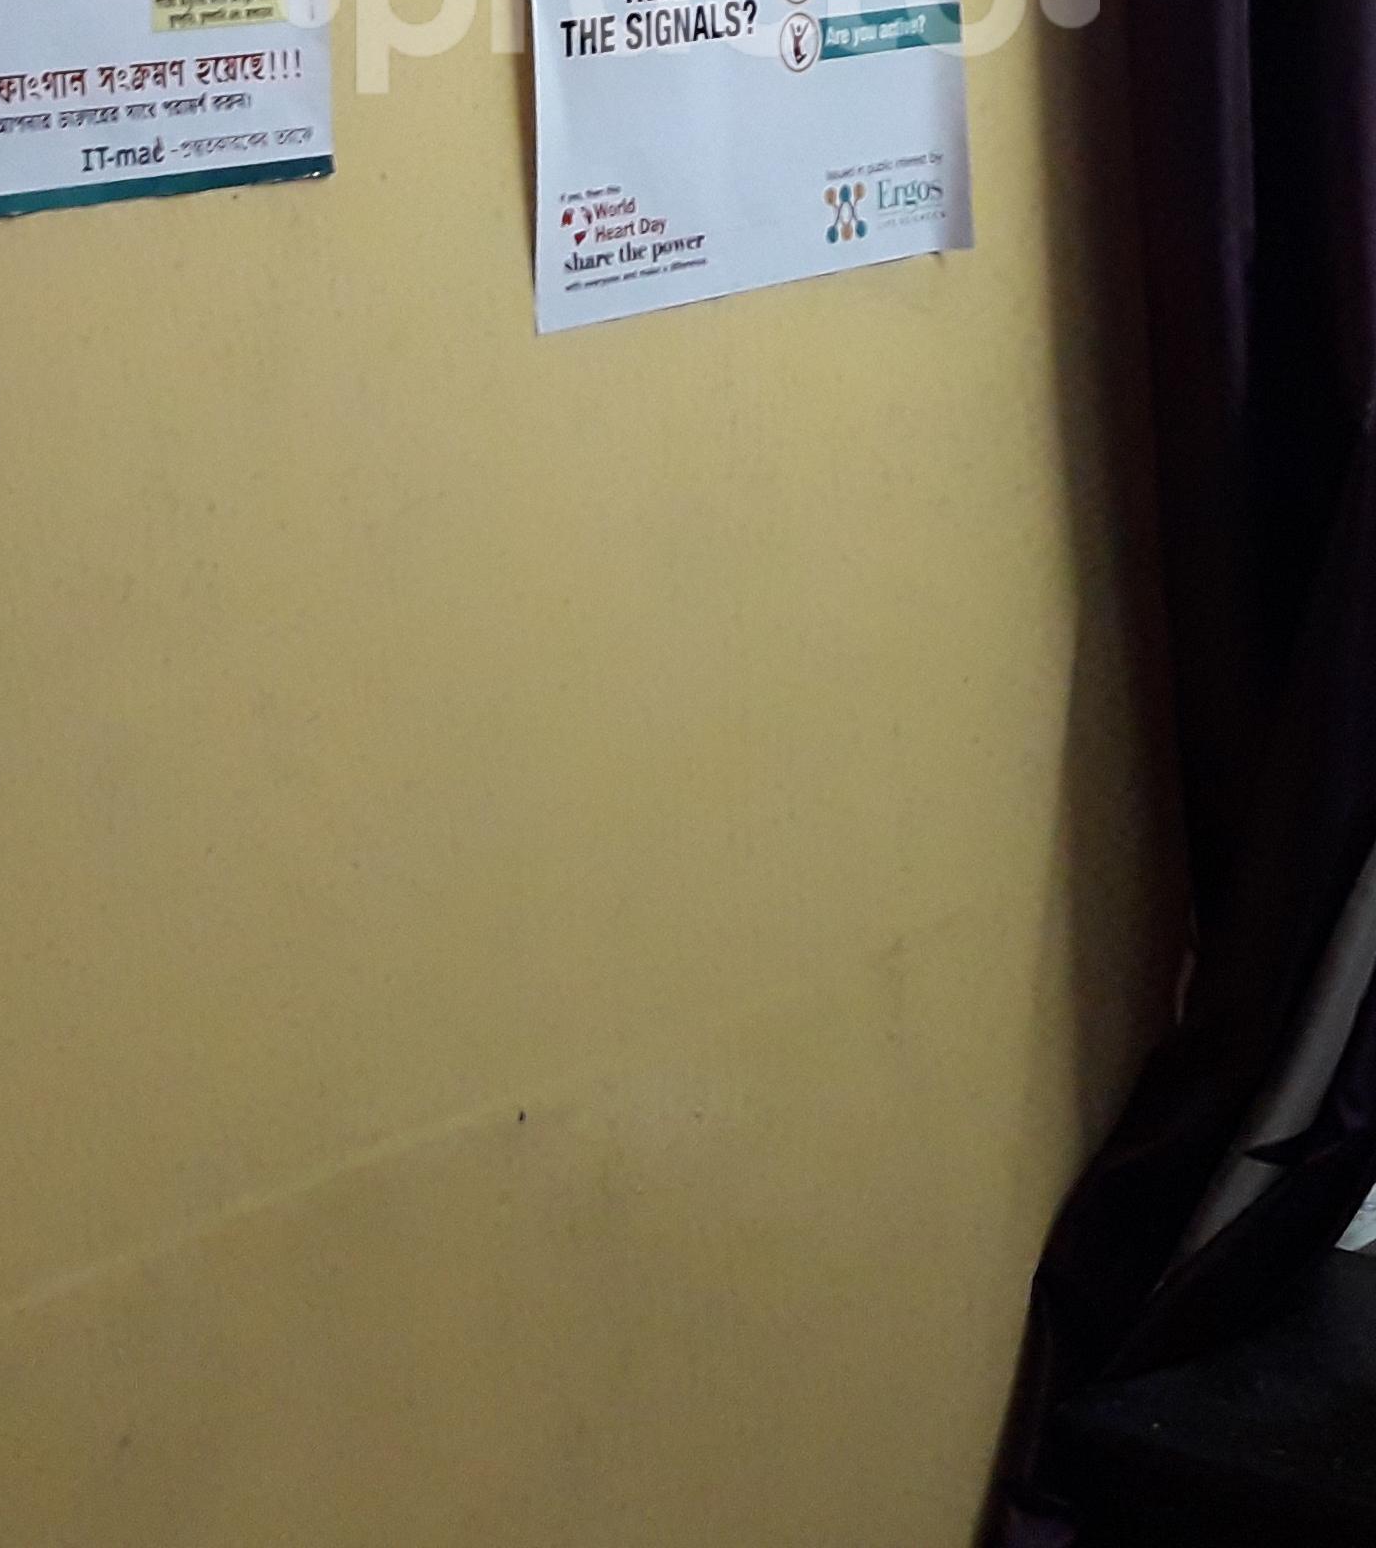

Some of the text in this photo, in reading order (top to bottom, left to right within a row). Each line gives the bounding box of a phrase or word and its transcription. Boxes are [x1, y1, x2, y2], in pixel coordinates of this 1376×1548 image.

[560, 0, 758, 57] THE SIGNALS?
[594, 197, 637, 219] World
[595, 217, 668, 243] Heart Day
[619, 241, 648, 264] the
[651, 234, 706, 263] power
